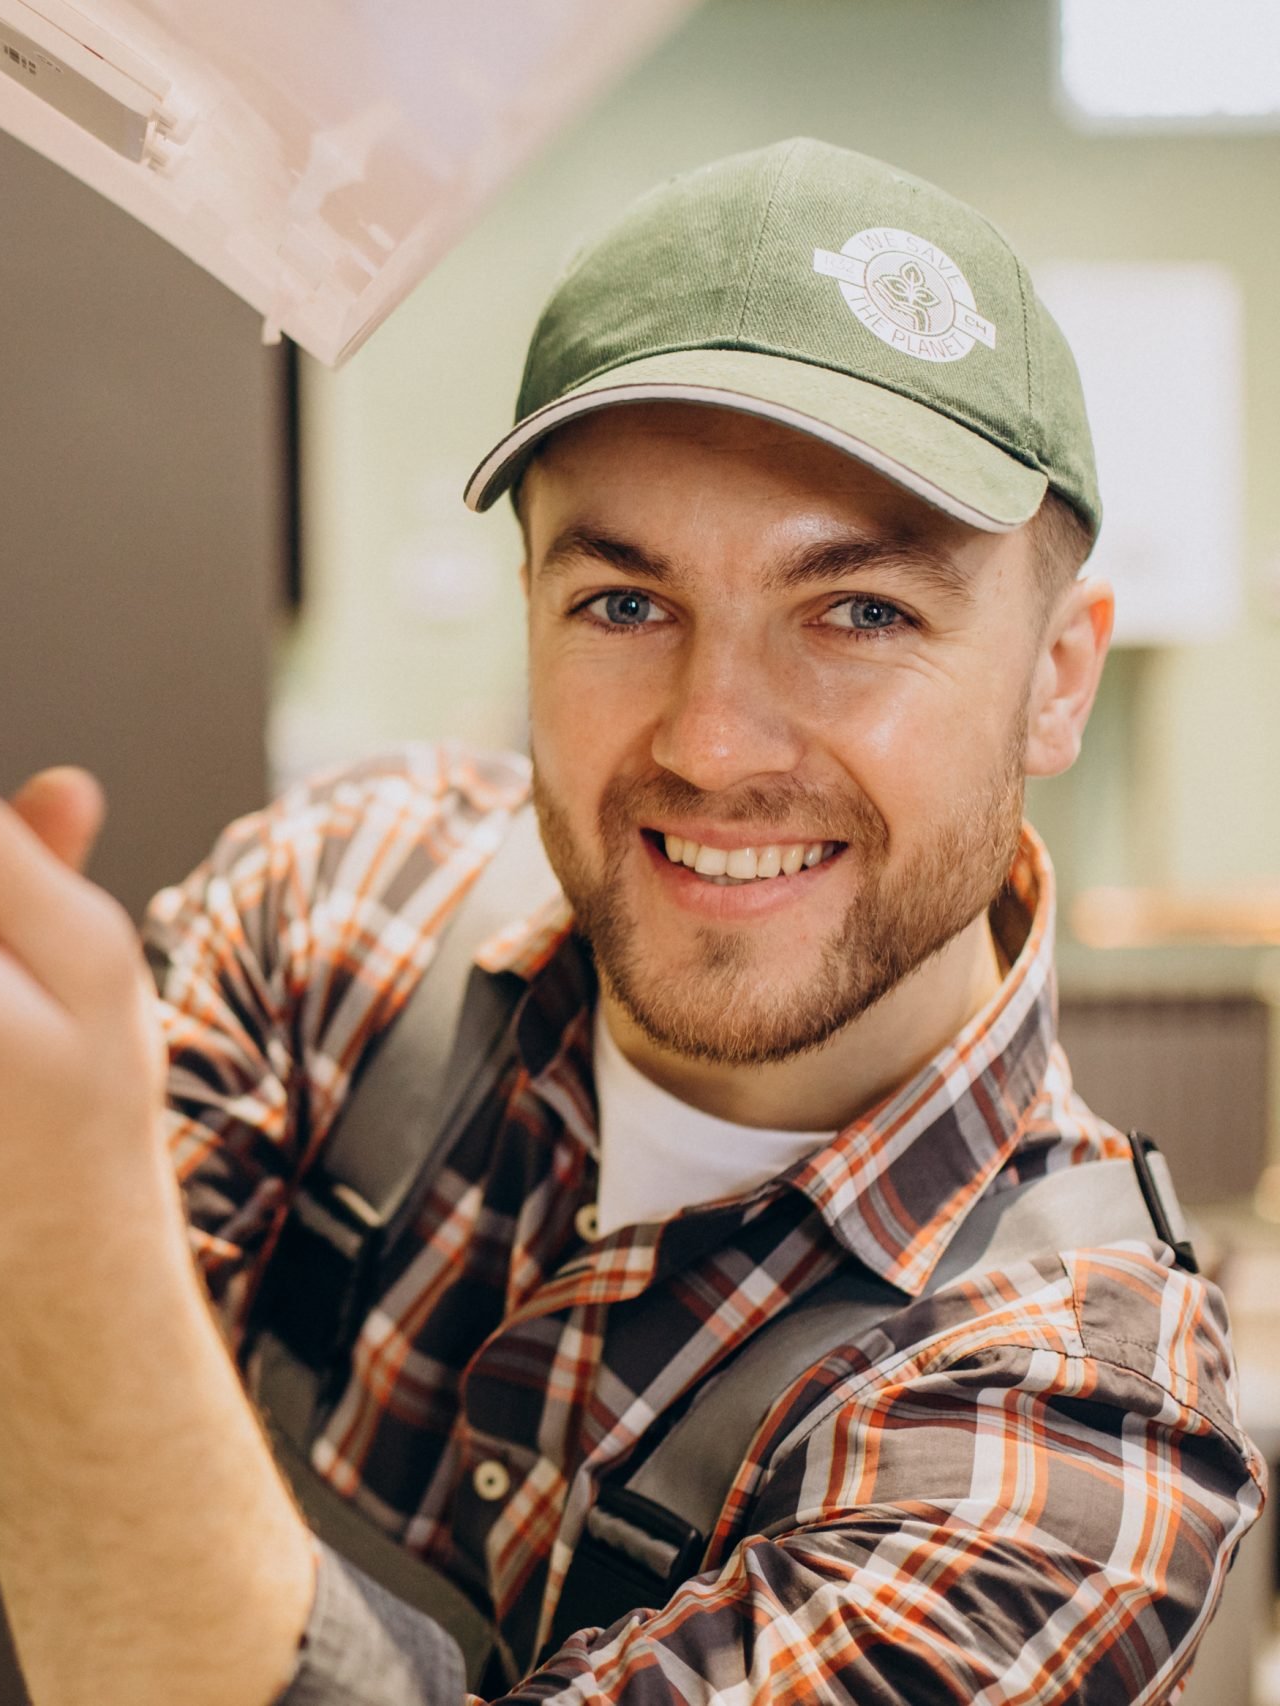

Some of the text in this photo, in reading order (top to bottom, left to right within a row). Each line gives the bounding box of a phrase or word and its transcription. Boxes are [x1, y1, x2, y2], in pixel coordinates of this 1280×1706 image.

[859, 231, 965, 287] WE SAVE
[849, 293, 965, 358] THE PLANET
